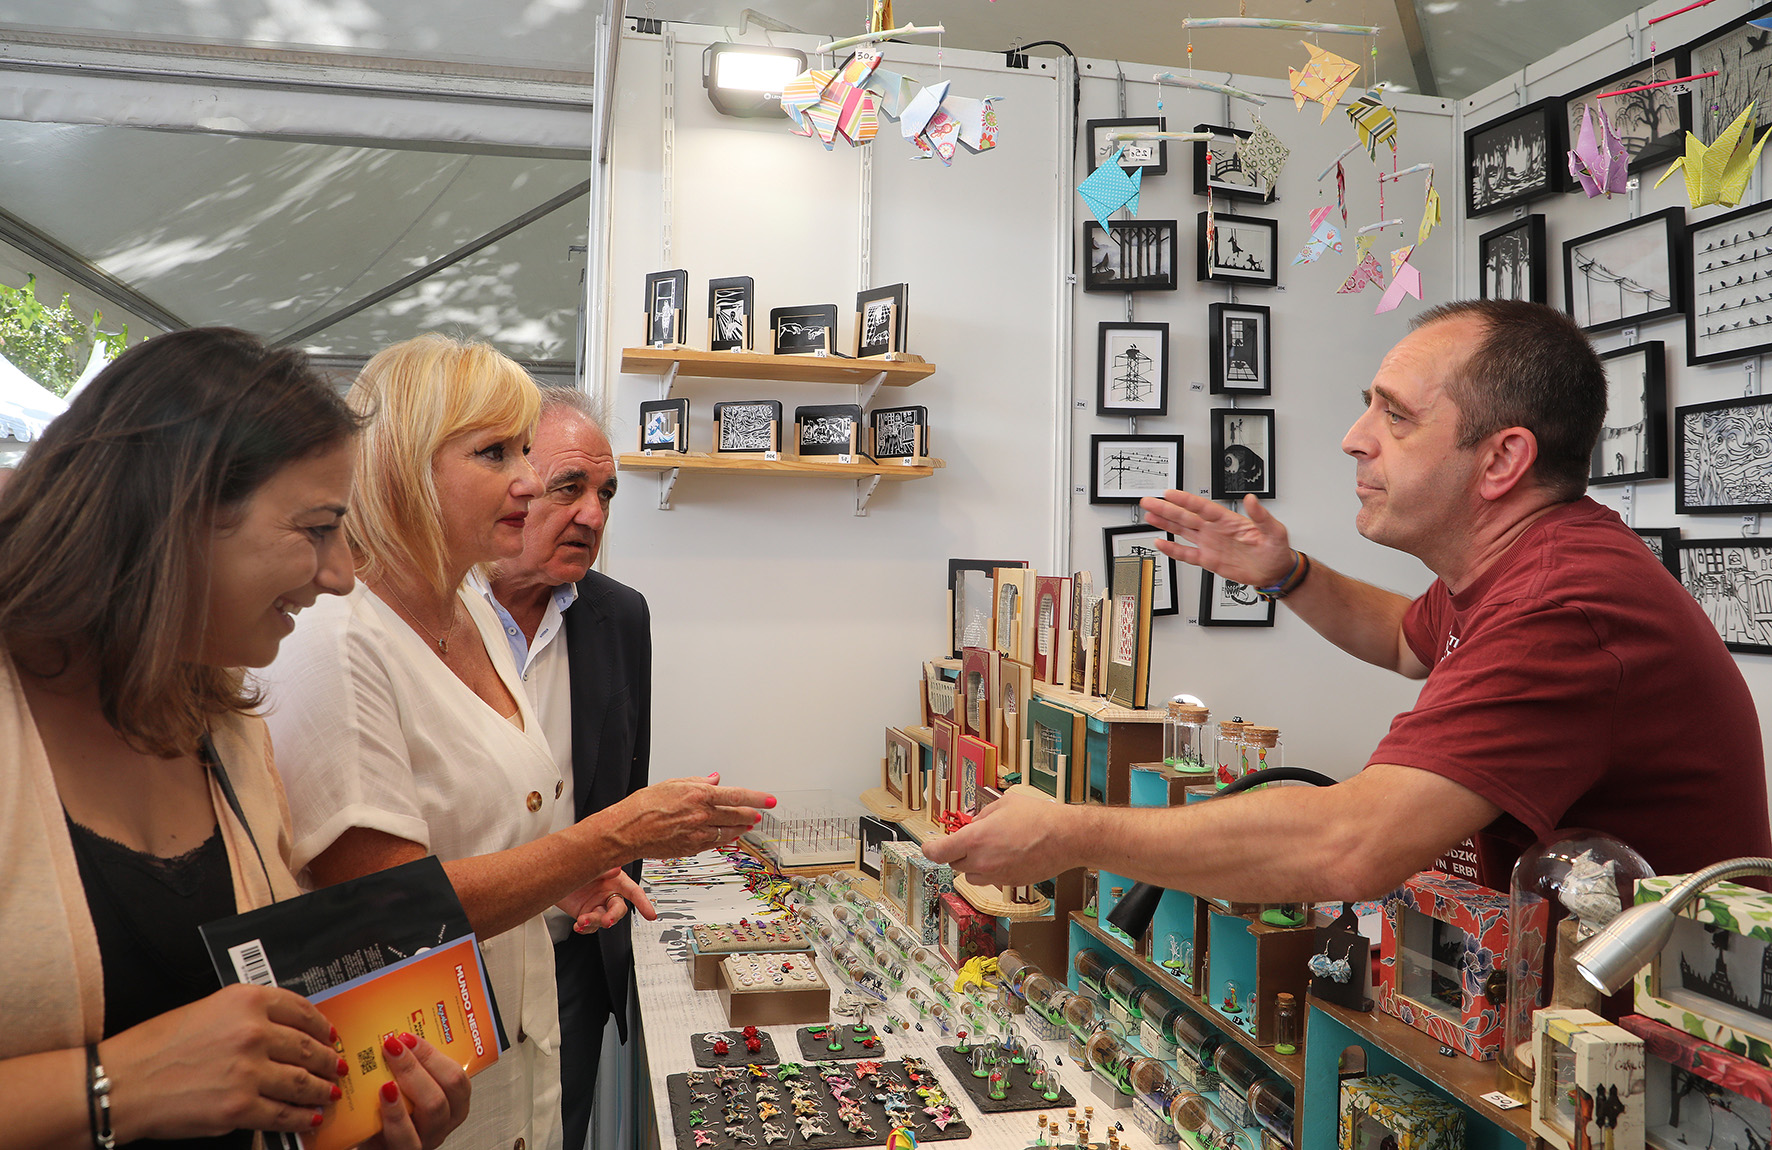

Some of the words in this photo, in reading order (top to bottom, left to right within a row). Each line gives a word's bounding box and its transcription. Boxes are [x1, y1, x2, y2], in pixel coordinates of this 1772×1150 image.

[455, 964, 472, 1011] MUNDO
[467, 1012, 484, 1056] NEGRO
[1440, 1046, 1452, 1056] 37
